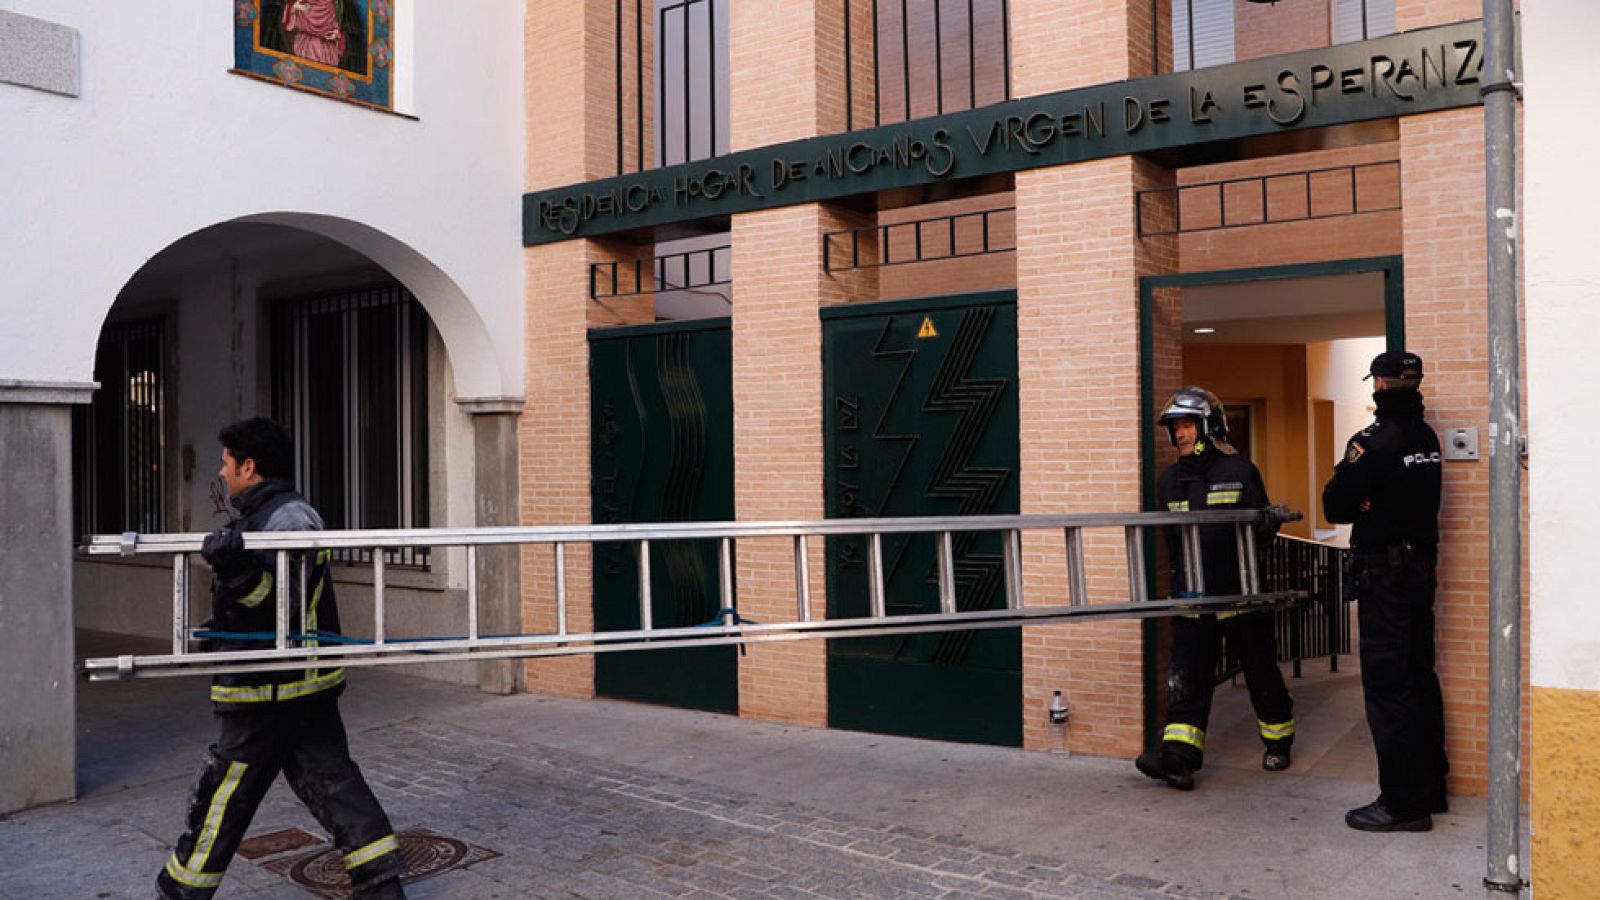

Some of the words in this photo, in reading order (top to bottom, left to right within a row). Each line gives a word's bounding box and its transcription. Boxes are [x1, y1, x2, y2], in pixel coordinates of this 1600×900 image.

[968, 103, 1108, 155] VIRGEN
[1122, 95, 1172, 135] DE
[1189, 86, 1222, 125] LA
